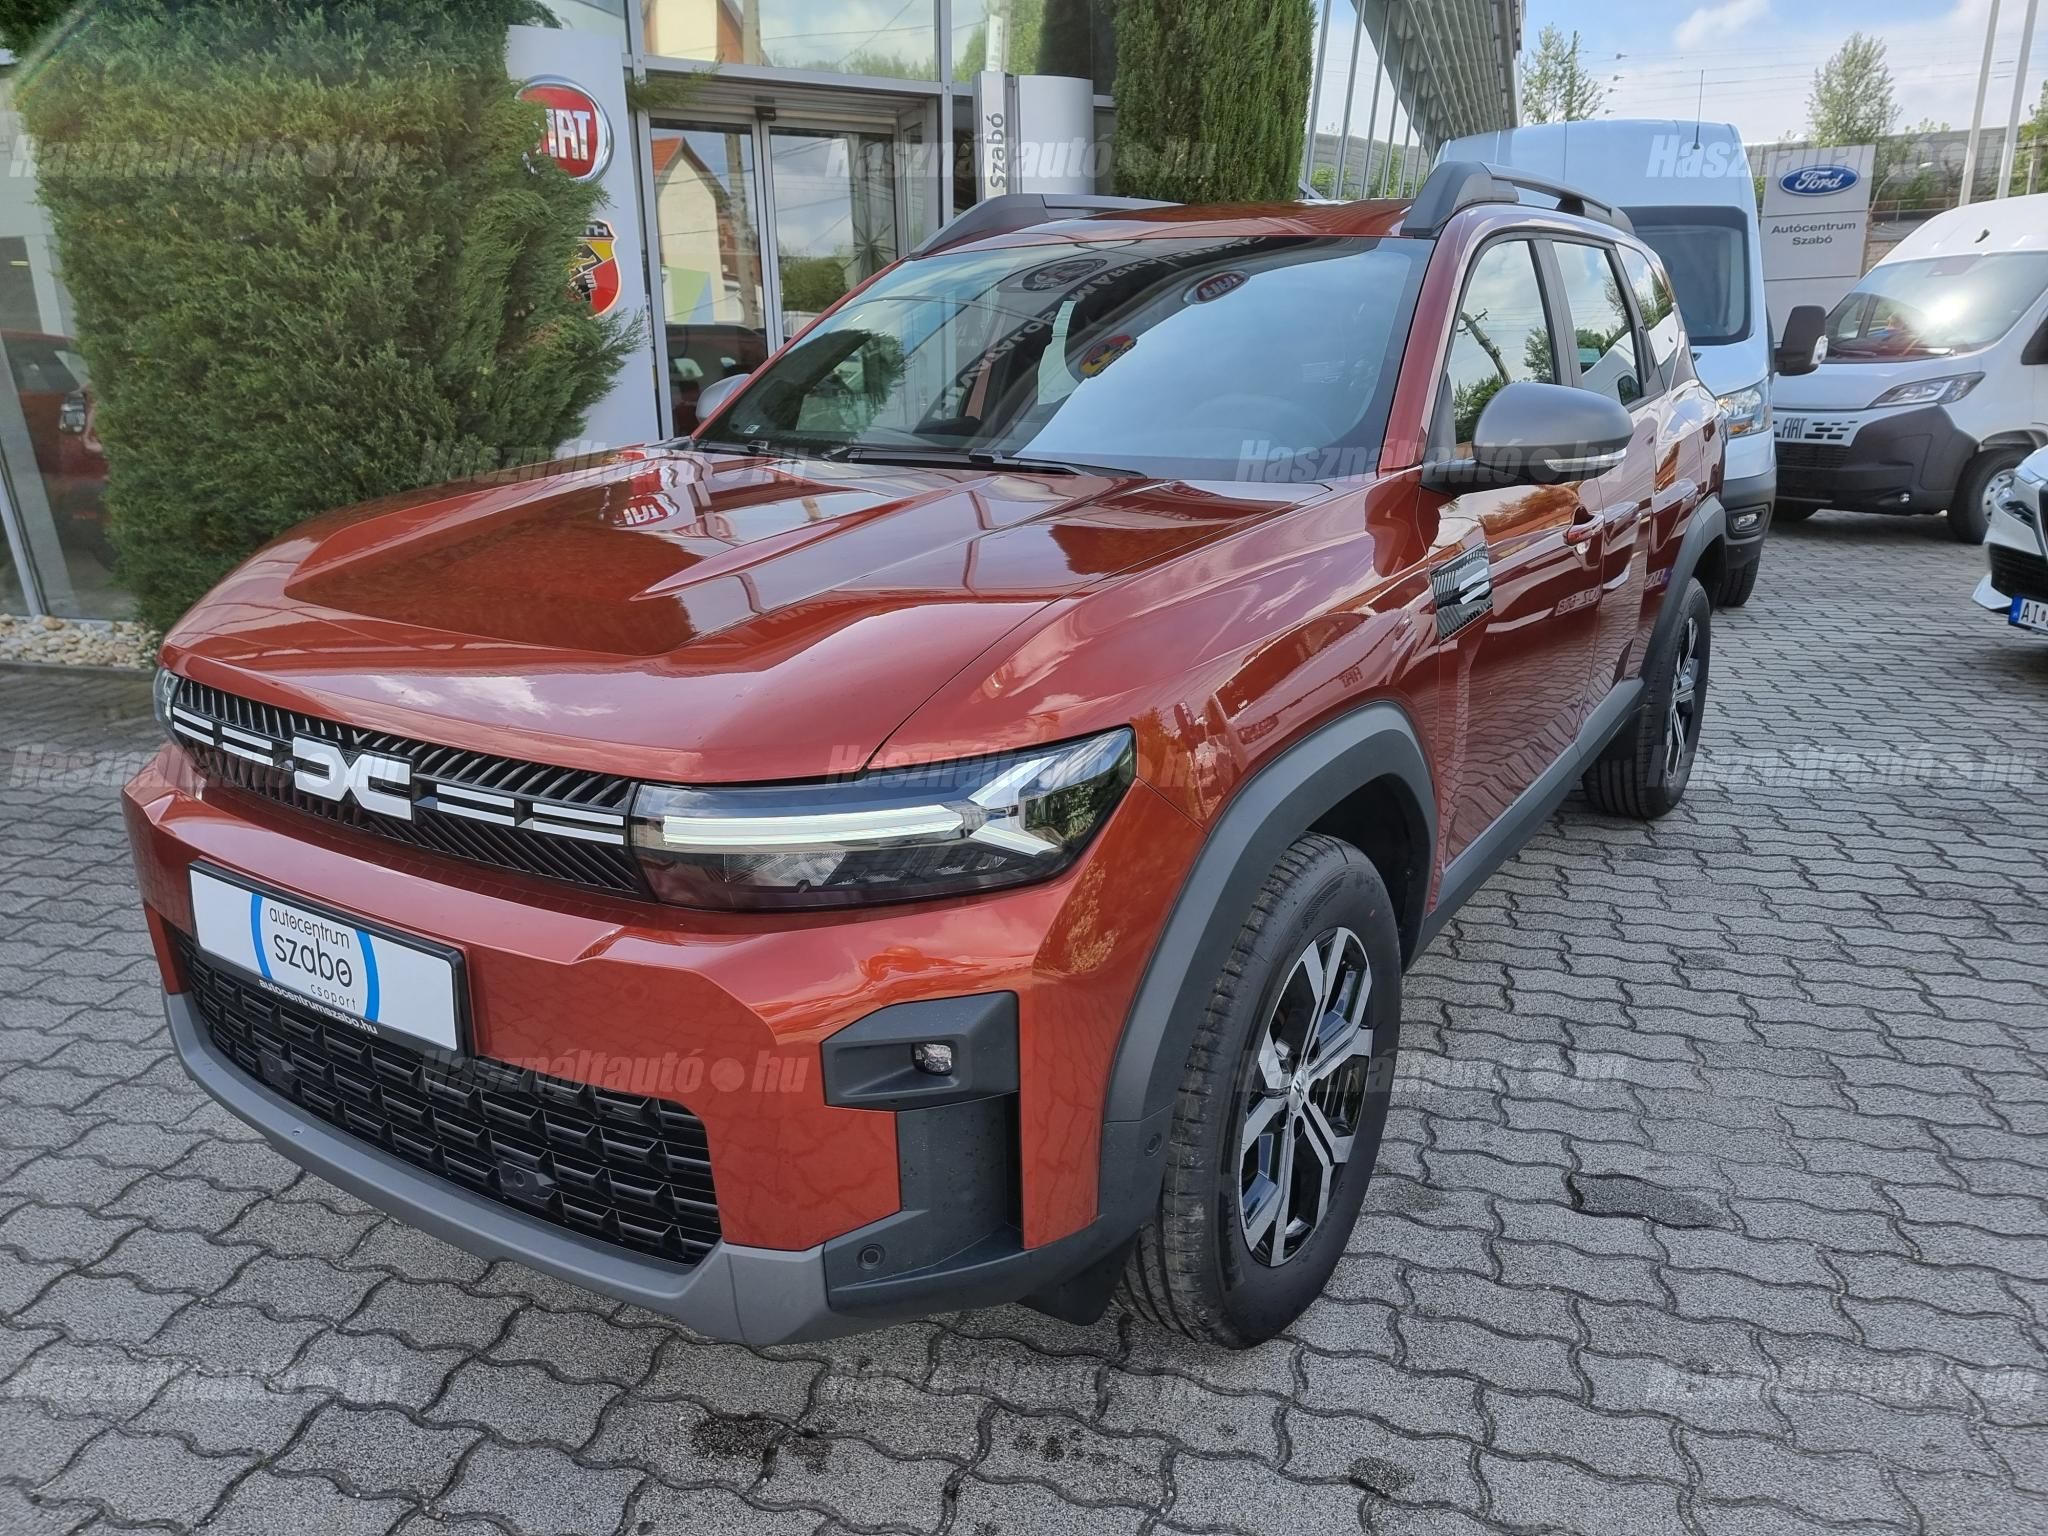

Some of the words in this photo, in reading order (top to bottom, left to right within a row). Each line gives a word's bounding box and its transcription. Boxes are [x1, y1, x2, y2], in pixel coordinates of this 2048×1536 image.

[545, 108, 591, 161] IAT
[986, 112, 1007, 188] Szabó
[1794, 170, 1845, 190] Ford
[1771, 222, 1857, 234] Autócentrum
[1792, 235, 1834, 246] Szabó
[1781, 417, 1808, 439] FIAT
[269, 907, 351, 950] autocentrum
[258, 979, 379, 1035] autocentrumszabo.hu
[310, 983, 357, 1011] csoport
